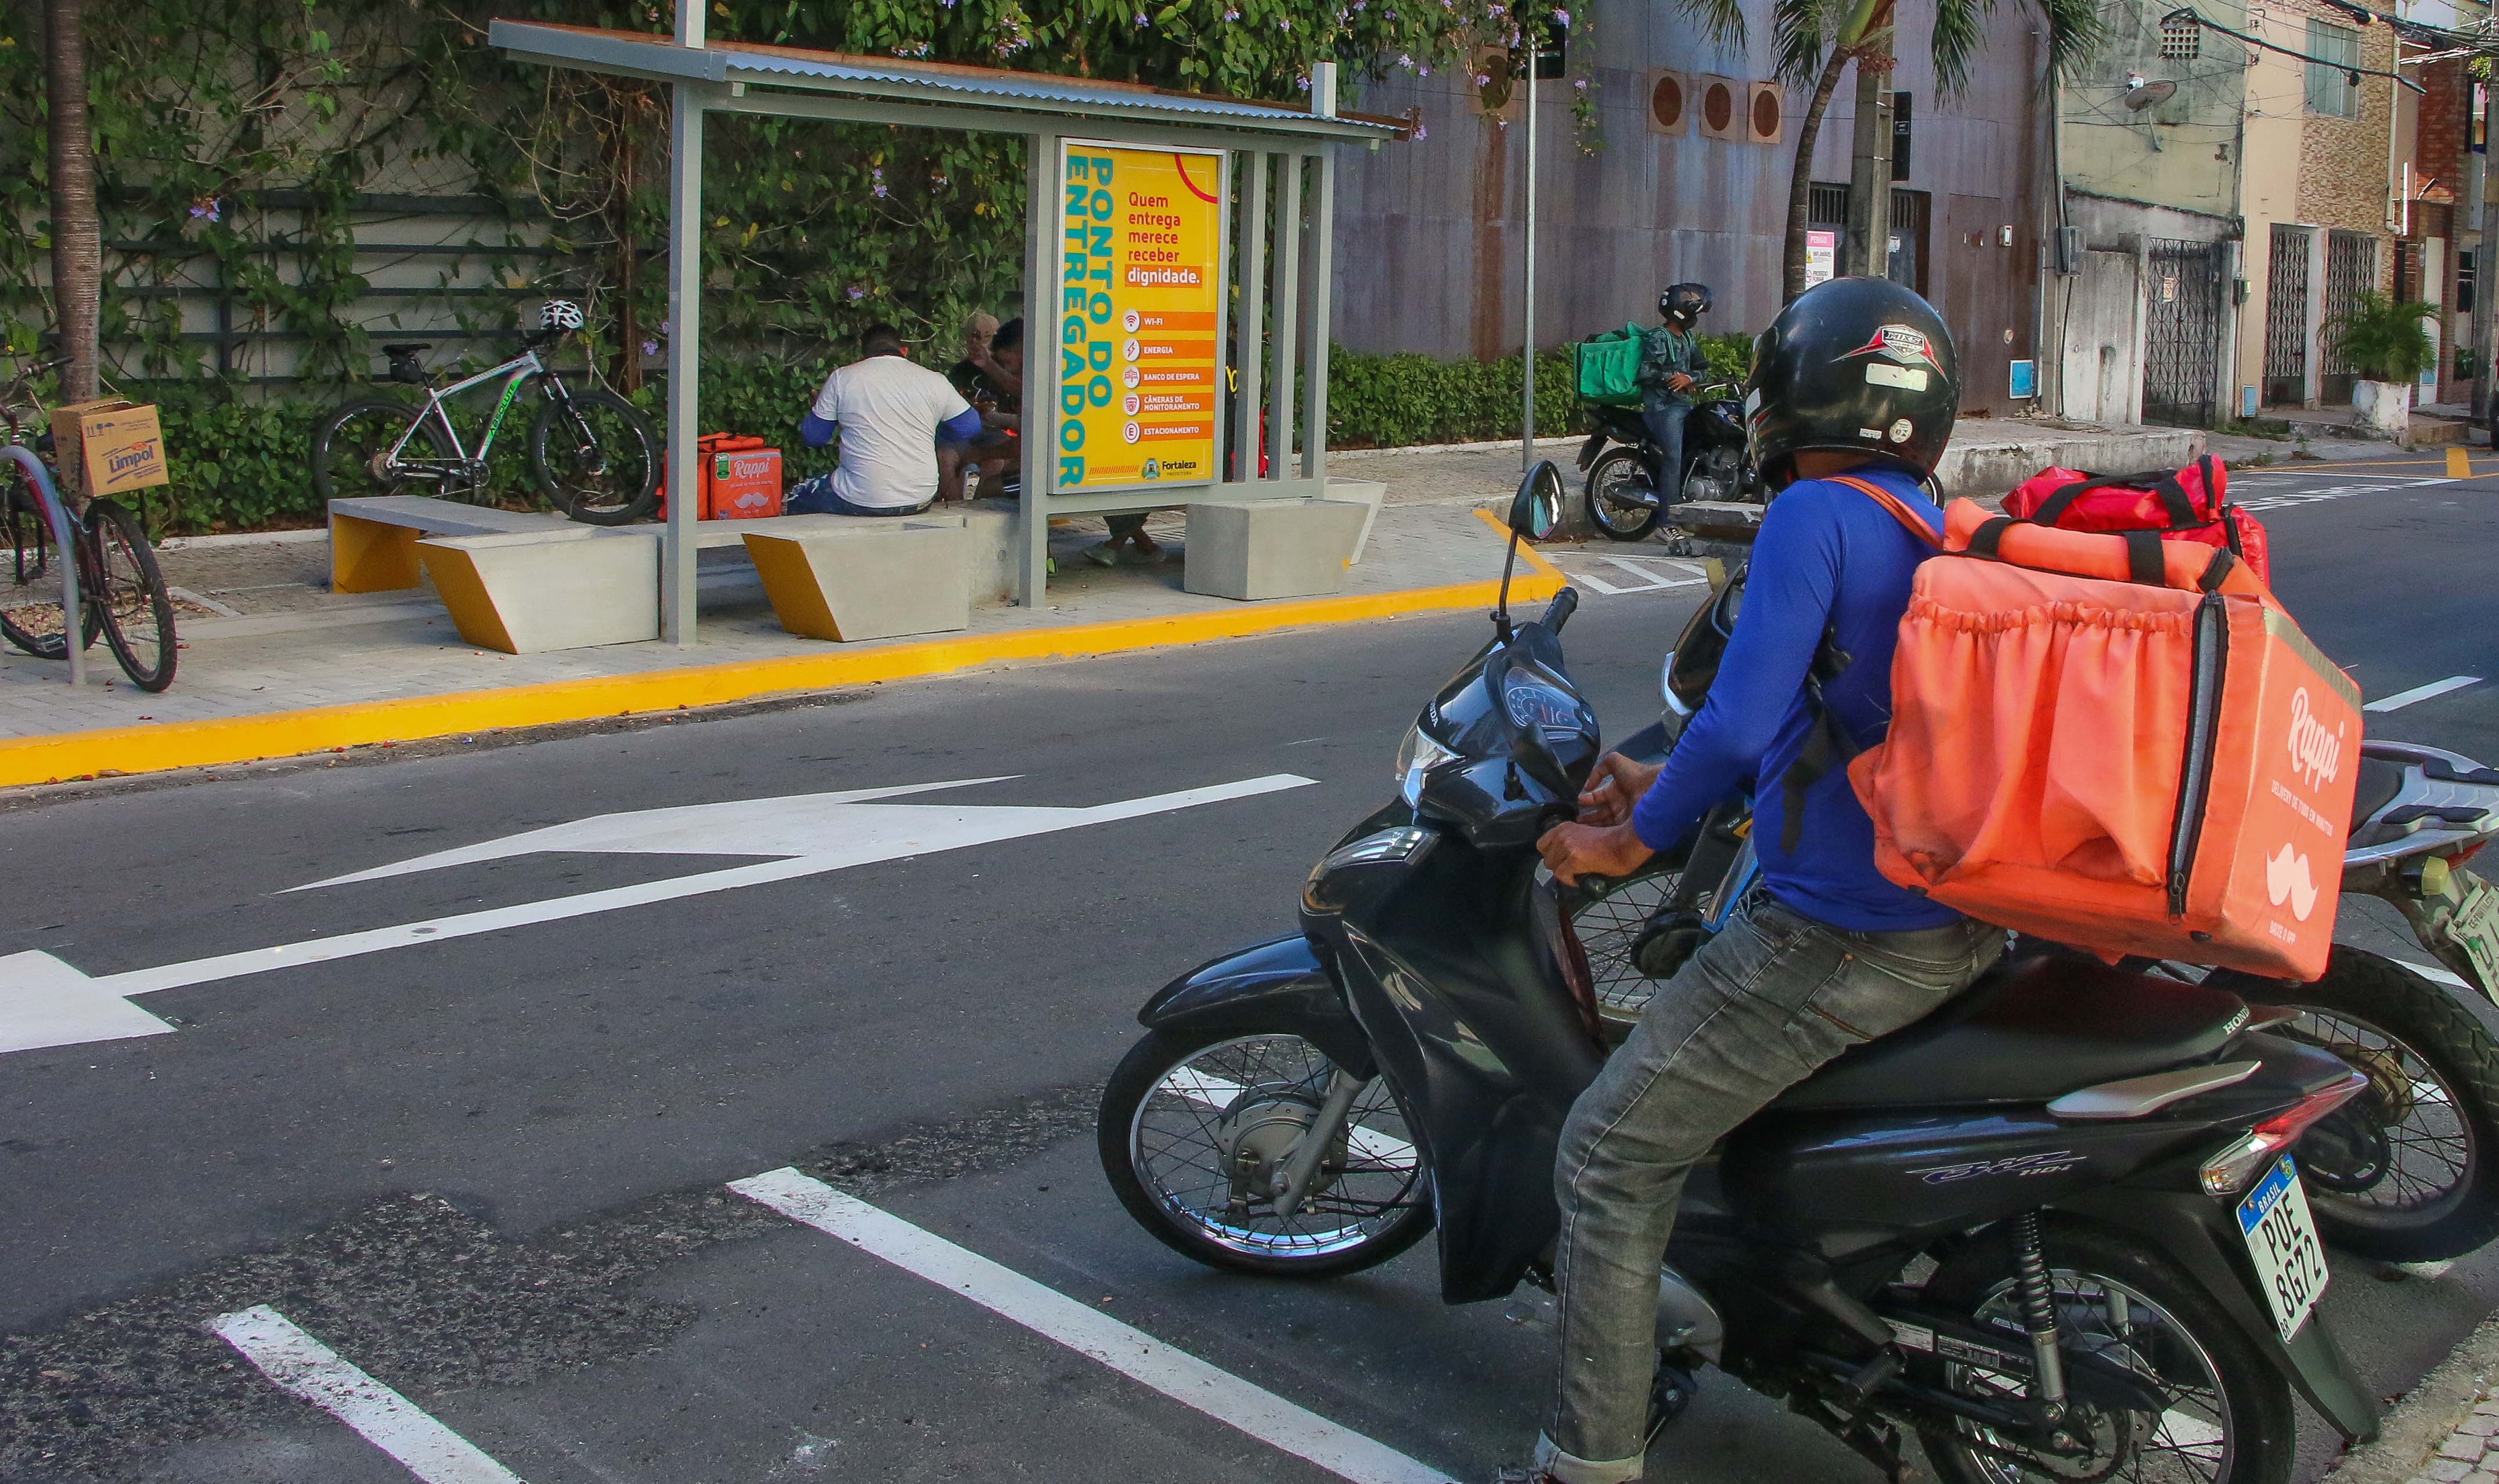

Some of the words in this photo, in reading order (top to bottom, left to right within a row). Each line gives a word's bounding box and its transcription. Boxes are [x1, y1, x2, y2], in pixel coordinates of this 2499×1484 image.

[1129, 192, 1169, 208] Quem
[1128, 212, 1181, 229] entrega
[1089, 157, 1113, 325] PONTO
[1128, 232, 1178, 244] merece
[1128, 247, 1180, 262] receber
[1128, 267, 1200, 287] dignidade.
[1059, 155, 1088, 488] ENTREGADOR
[1144, 317, 1163, 326] WI-FI
[1885, 331, 1921, 345] MIXS
[1144, 346, 1174, 355] ENERGIA
[1088, 341, 1112, 407] DO
[1175, 373, 1200, 381] ESPERA
[1144, 394, 1173, 403] CÂMERAS
[1144, 403, 1200, 411] MONITORAMENTO
[1144, 426, 1200, 435] ESTACIONAMENTO
[109, 445, 154, 474] Limpol
[734, 457, 771, 479] Rappi
[1162, 460, 1196, 470] Fortaleza
[2287, 687, 2345, 794] Rappi
[2271, 779, 2292, 806] DELIVERY
[2258, 1182, 2282, 1215] BRASIL
[2262, 1191, 2303, 1268] POE
[2276, 1234, 2322, 1319] 8G72
[2279, 1317, 2292, 1339] BR
